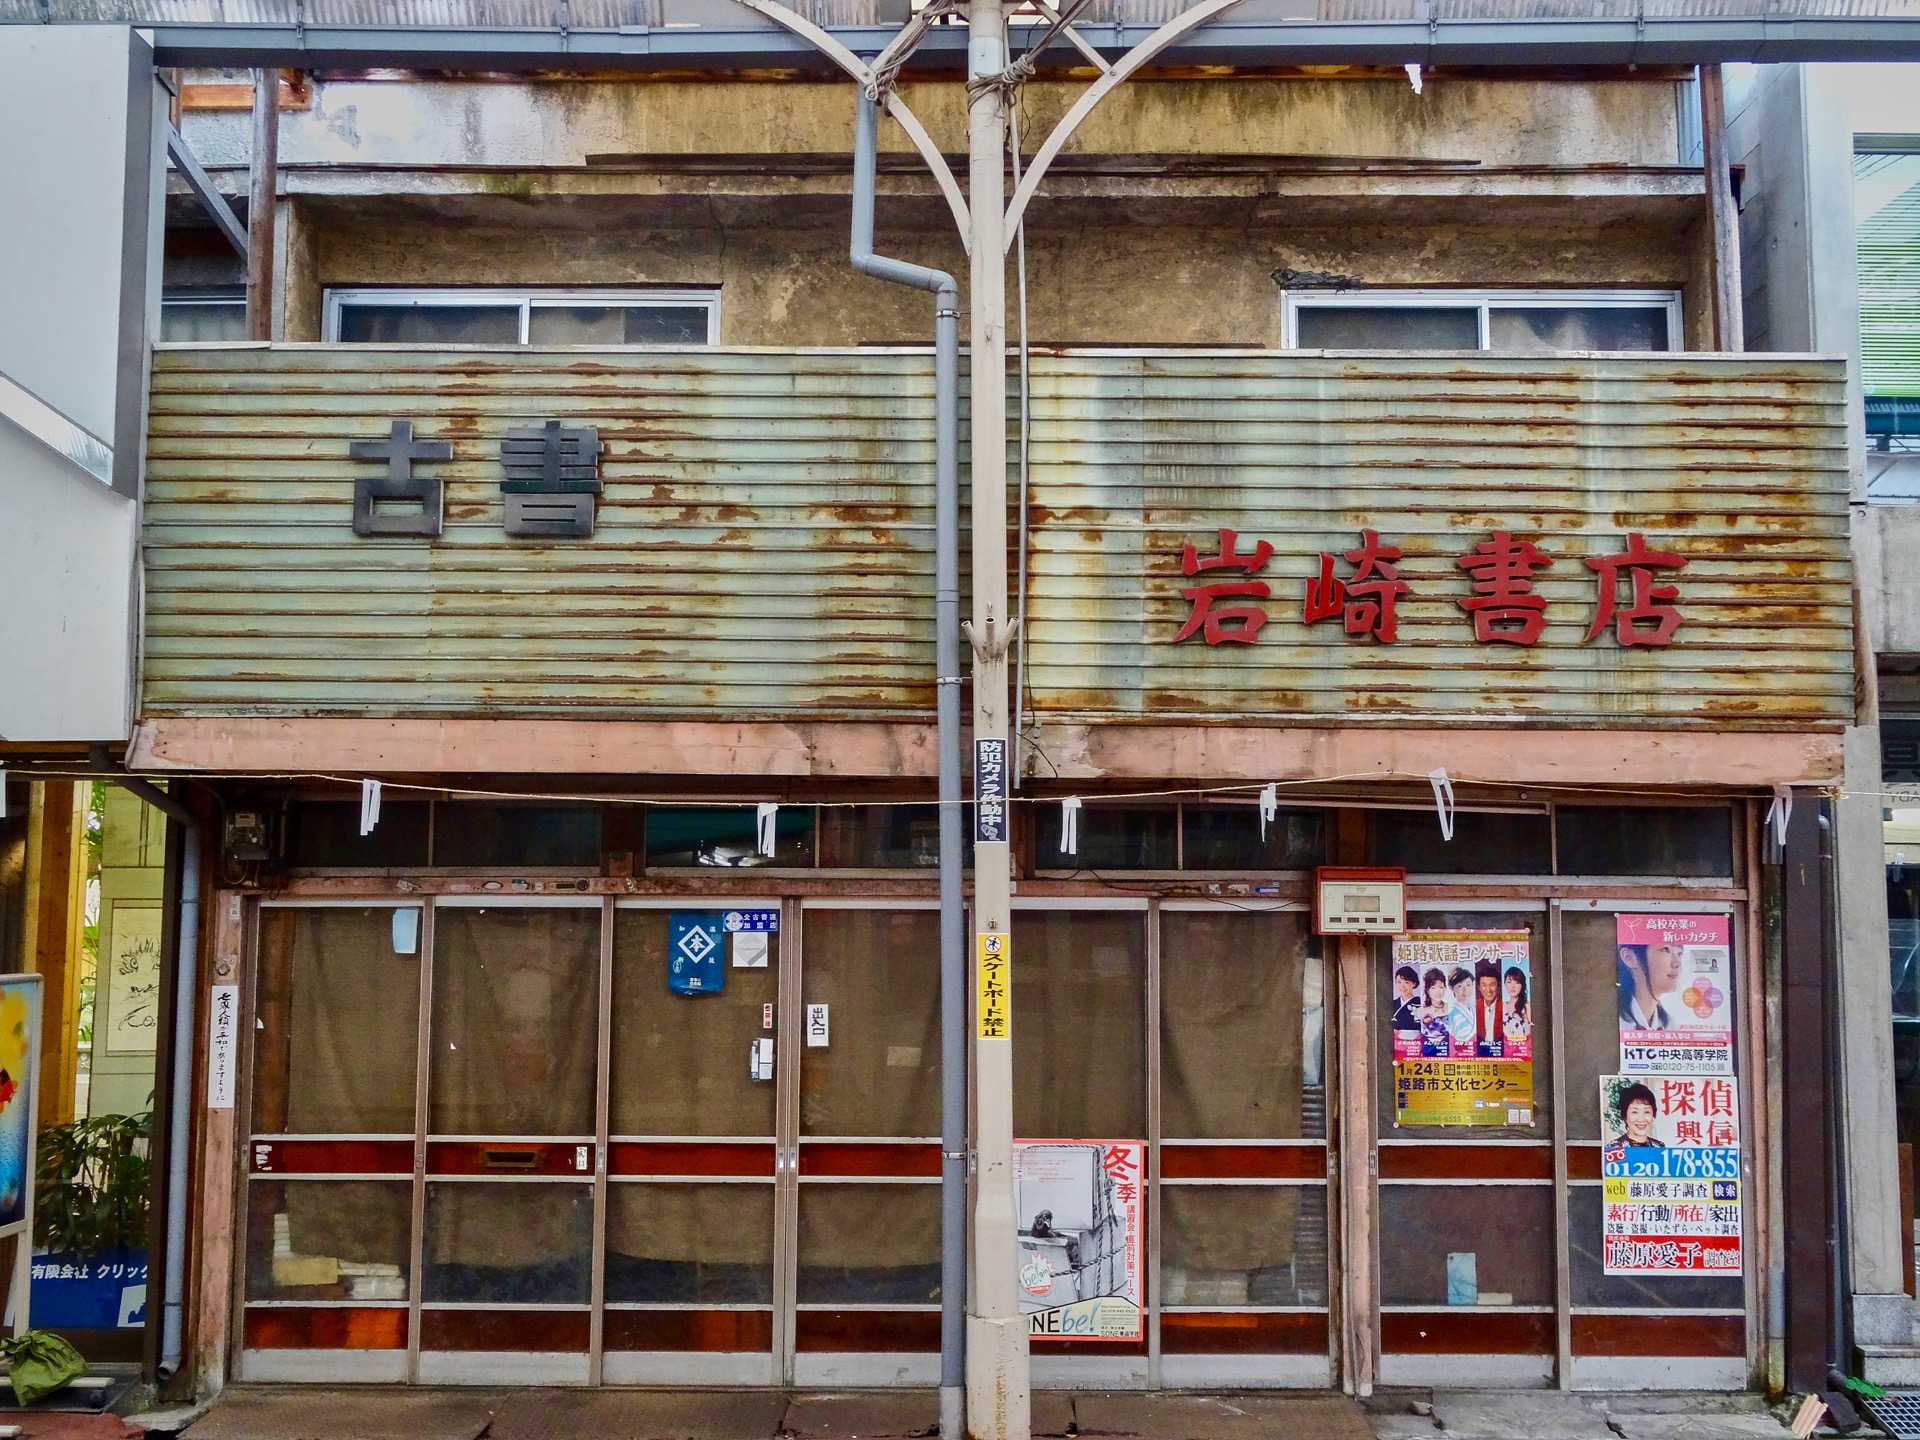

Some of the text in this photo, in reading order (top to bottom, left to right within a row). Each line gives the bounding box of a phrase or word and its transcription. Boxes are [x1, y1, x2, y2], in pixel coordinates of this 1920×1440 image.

[350, 421, 604, 535] 古書
[1173, 528, 1688, 646] 岩崎書店
[980, 741, 1002, 826] 防犯カメラ作動中
[1646, 918, 1697, 930] 高校卒業の
[688, 934, 706, 953] 本
[1663, 931, 1719, 943] 新しいカタチ
[1397, 943, 1527, 962] 姫路歌謡コンサート
[983, 953, 1004, 1037] スケートボード禁止
[1624, 1048, 1728, 1061] KTC 中央高等学院
[1662, 1063, 1716, 1071] 0120-75-1105
[1397, 1077, 1519, 1092] 姫路市文化センター
[1660, 1079, 1733, 1117] 探偵
[1675, 1120, 1734, 1147] 興信
[1102, 1145, 1139, 1204] 冬季
[1605, 1148, 1738, 1178] 0120 178-855
[1606, 1181, 1736, 1198] web 藤原愛子調査 検索
[1607, 1241, 1739, 1268] 藤原愛子 調査室
[31, 1263, 90, 1279] 有限会社
